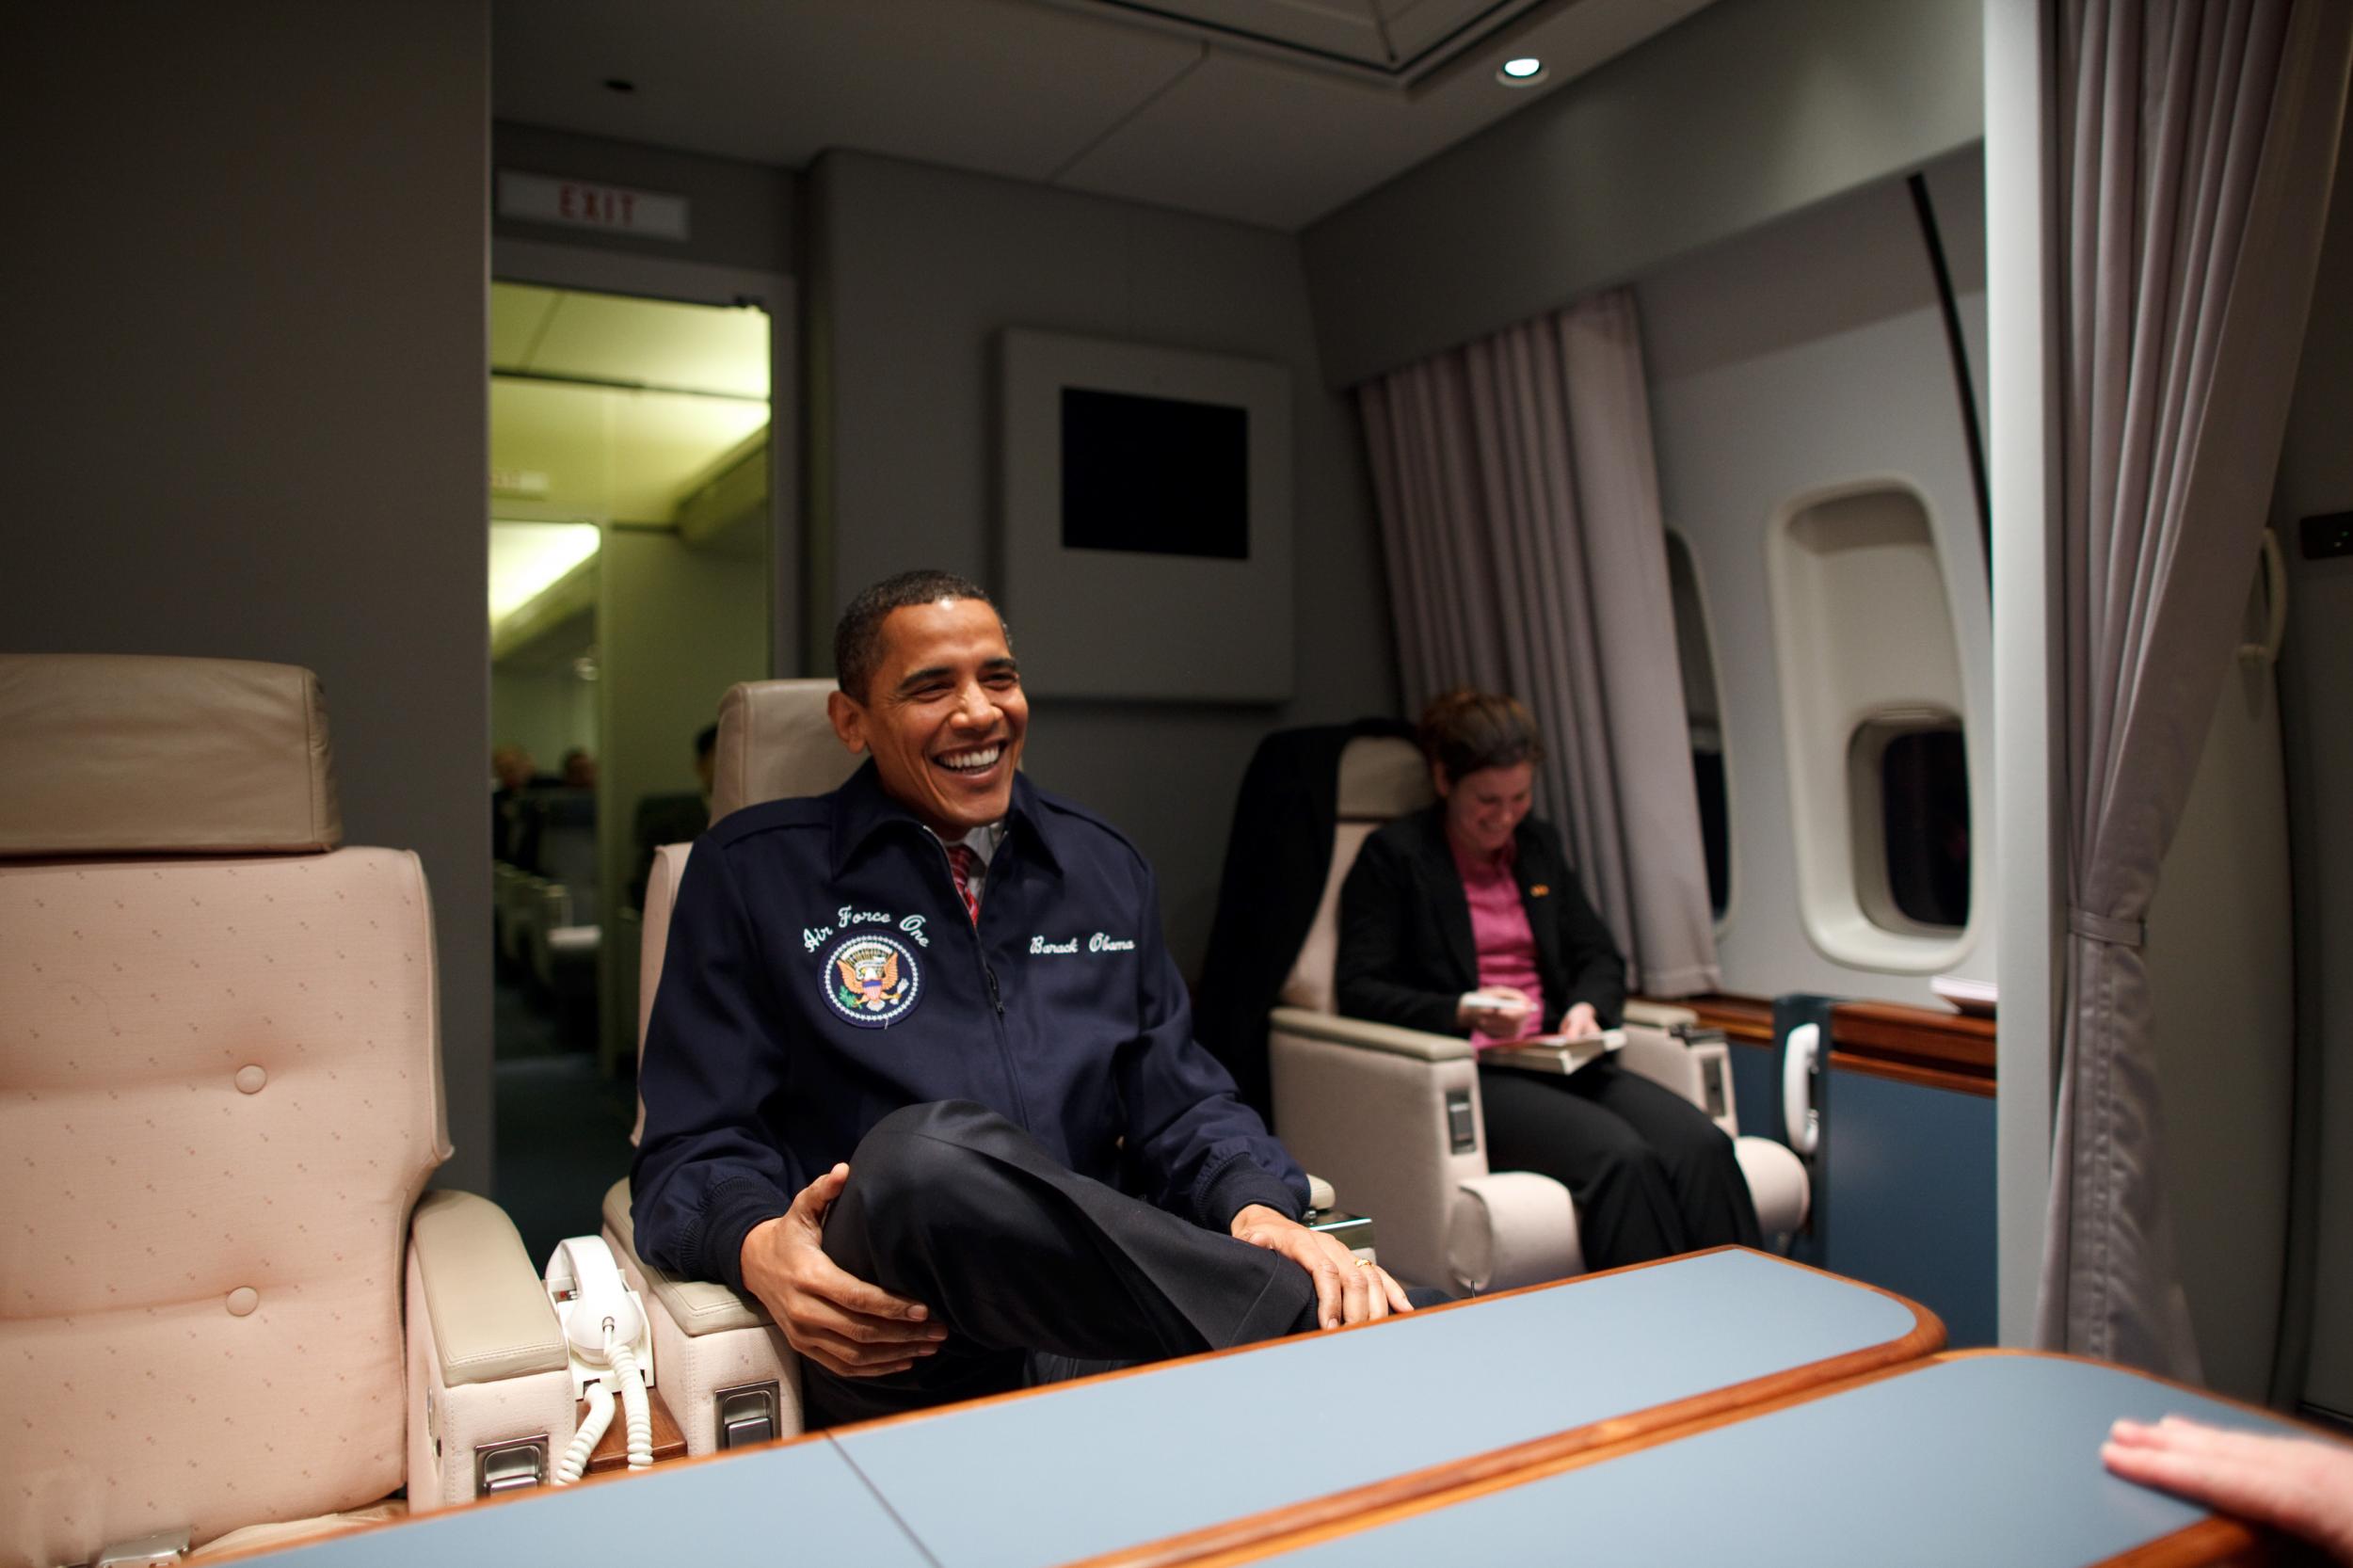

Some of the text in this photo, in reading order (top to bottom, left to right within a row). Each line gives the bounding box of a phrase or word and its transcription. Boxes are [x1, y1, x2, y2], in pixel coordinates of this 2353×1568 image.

[559, 181, 639, 227] EXIT
[803, 904, 930, 952] Air Force One
[1030, 932, 1135, 954] Barack Obama
